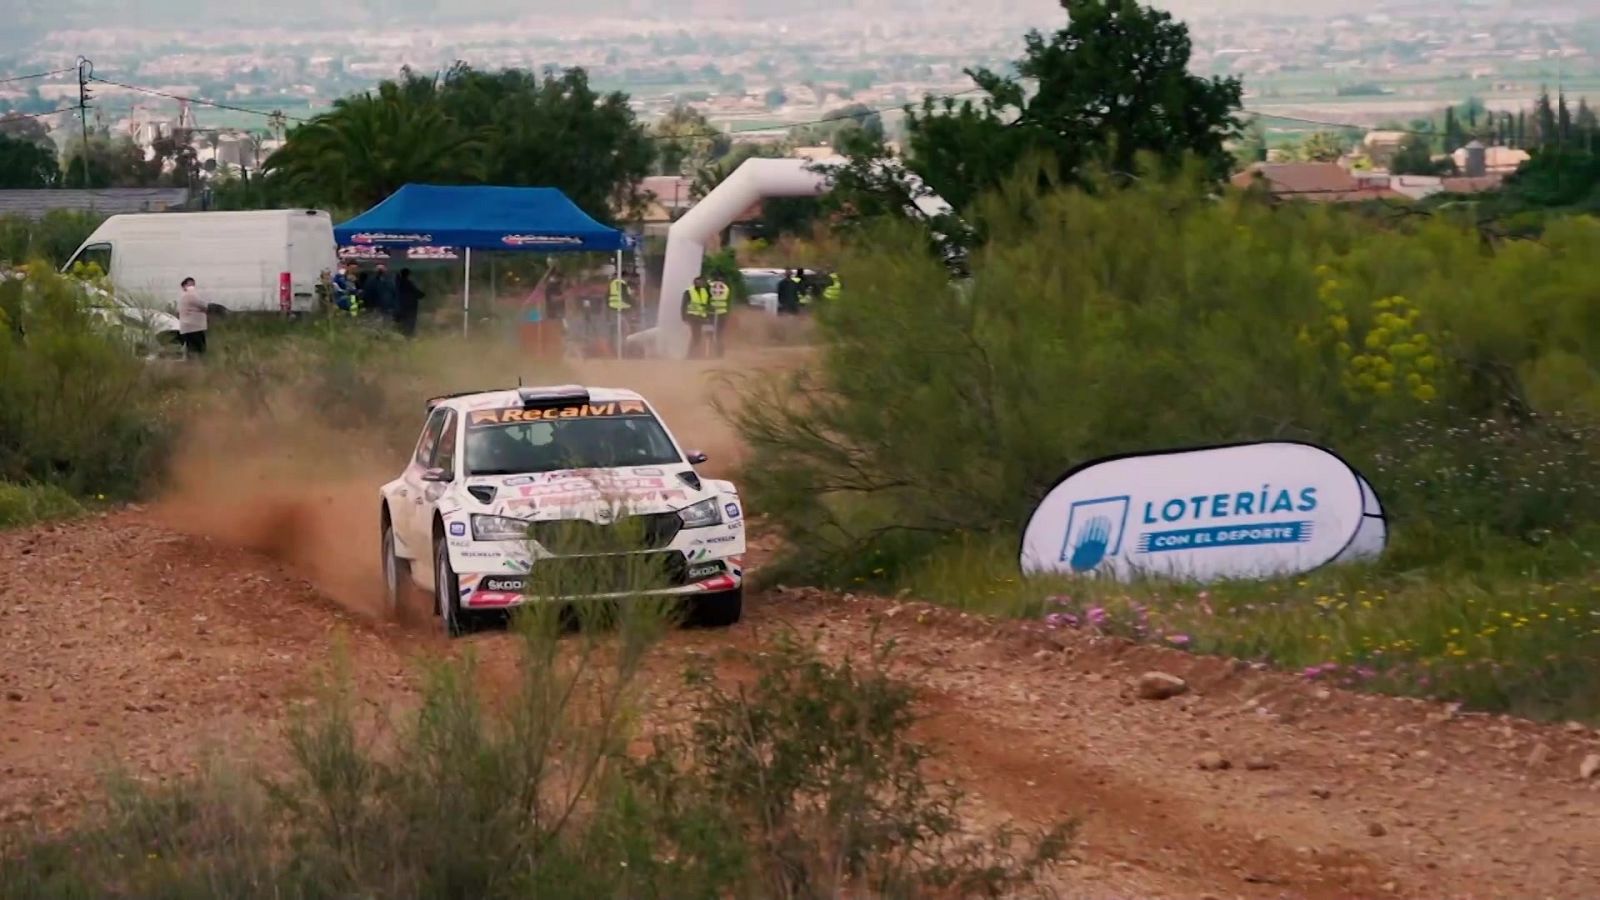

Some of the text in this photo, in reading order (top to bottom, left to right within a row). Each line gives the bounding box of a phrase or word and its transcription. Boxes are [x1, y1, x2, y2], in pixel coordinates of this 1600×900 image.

[501, 403, 616, 422] Recalvi
[1143, 483, 1317, 524] LOTERÍAS
[1155, 527, 1294, 547] CON EL DEPORTE
